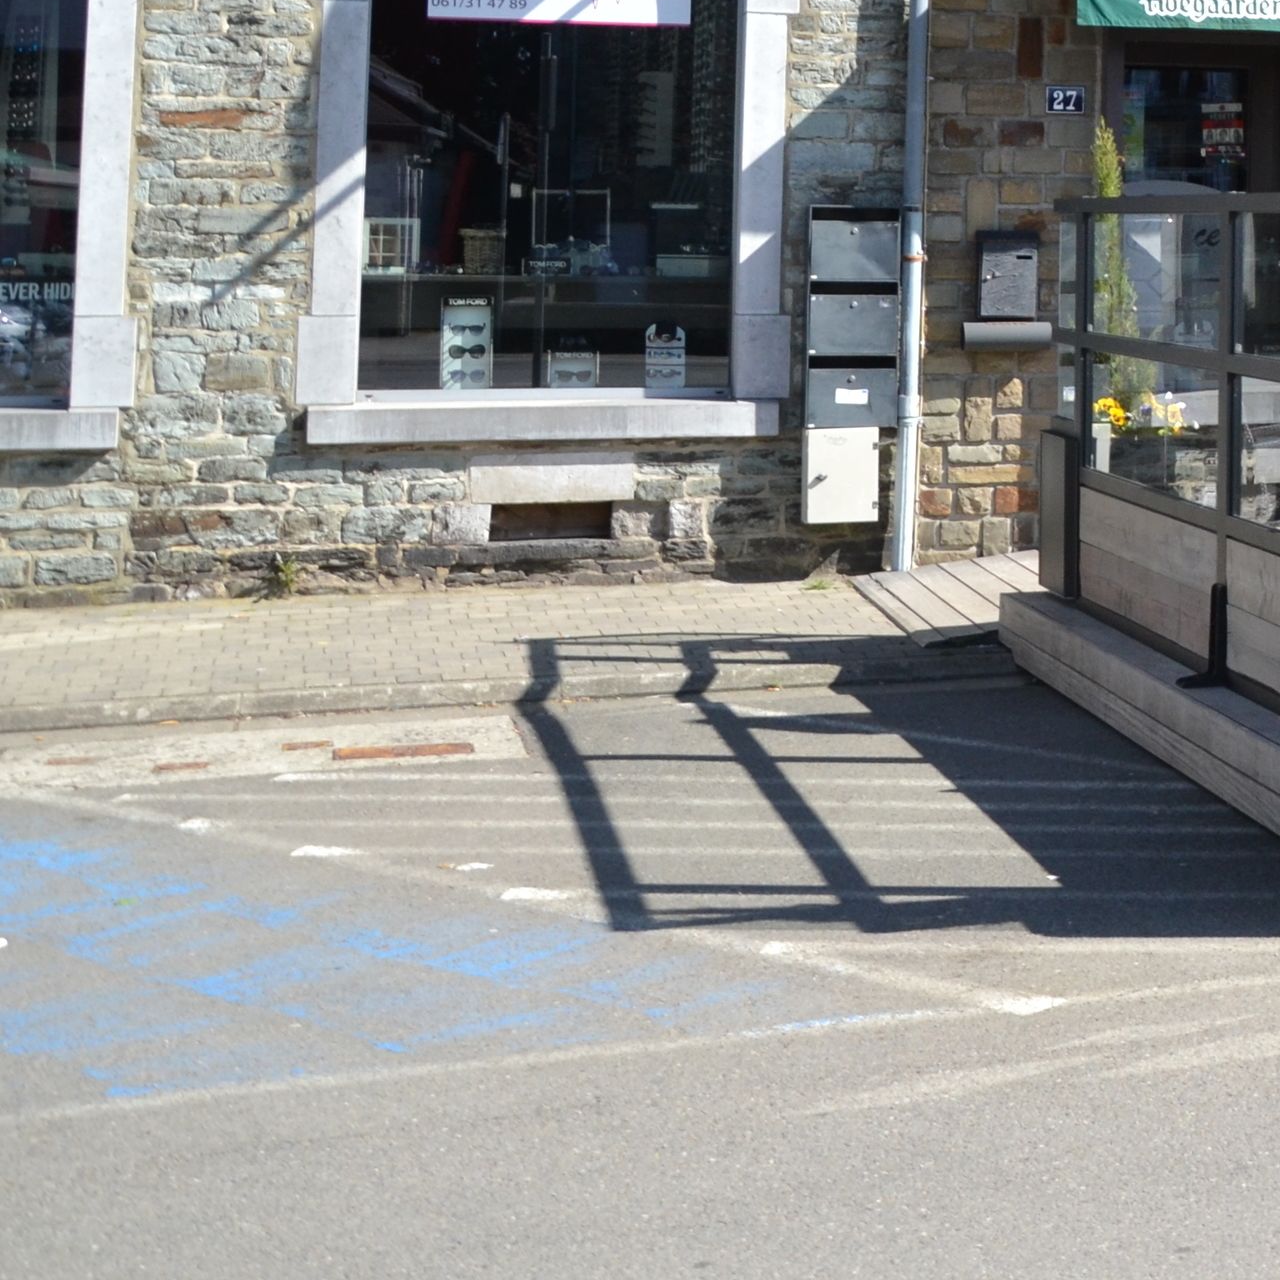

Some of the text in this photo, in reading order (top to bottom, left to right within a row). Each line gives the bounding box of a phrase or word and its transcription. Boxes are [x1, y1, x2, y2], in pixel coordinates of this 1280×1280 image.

[1053, 91, 1077, 110] 27
[448, 298, 488, 306] TOM FORD
